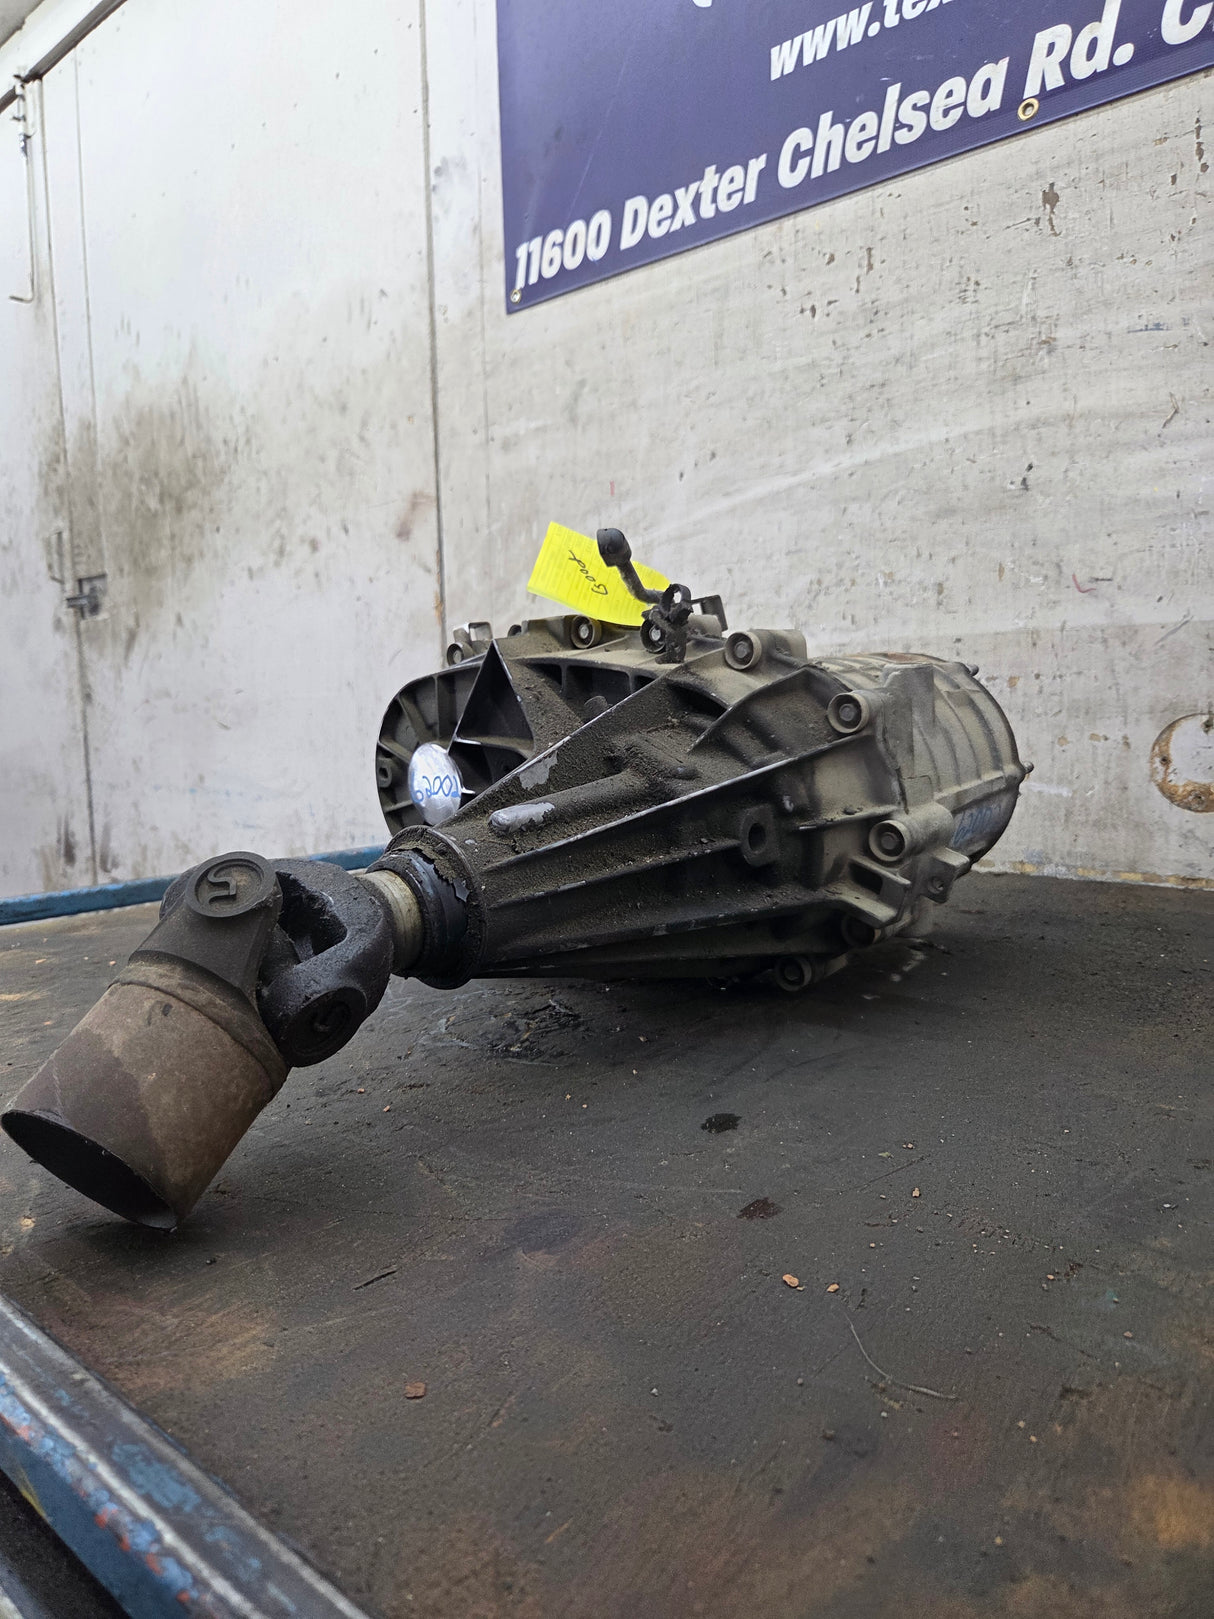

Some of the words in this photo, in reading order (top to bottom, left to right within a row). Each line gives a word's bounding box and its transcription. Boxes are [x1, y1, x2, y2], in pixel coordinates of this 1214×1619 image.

[770, 0, 953, 81] www.te
[515, 209, 612, 290] 11600
[620, 153, 767, 251] Dexter
[777, 56, 1010, 189] Chelsea
[1022, 0, 1135, 99] Rd.
[567, 549, 609, 596] Good
